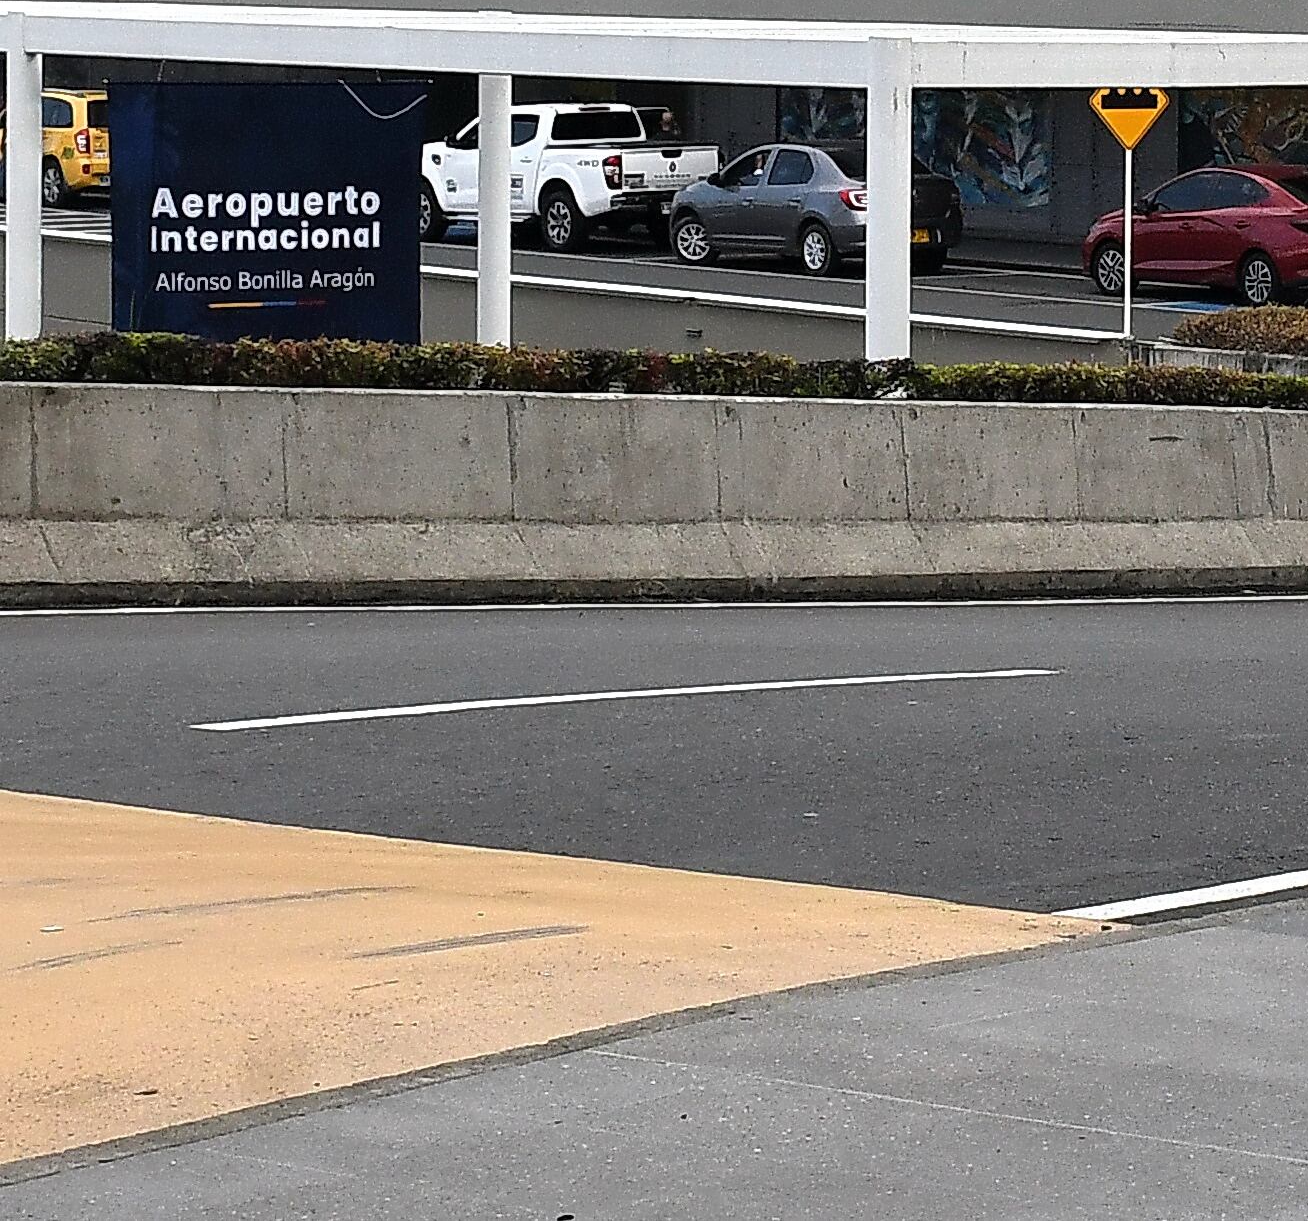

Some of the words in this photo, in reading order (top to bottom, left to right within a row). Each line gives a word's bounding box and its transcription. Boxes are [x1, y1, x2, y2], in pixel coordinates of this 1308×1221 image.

[152, 186, 381, 227] Aeropuerto
[151, 220, 380, 252] Internacional
[155, 272, 232, 292] Alfonso
[238, 270, 303, 290] Bonilla
[310, 267, 375, 291] Aragón
